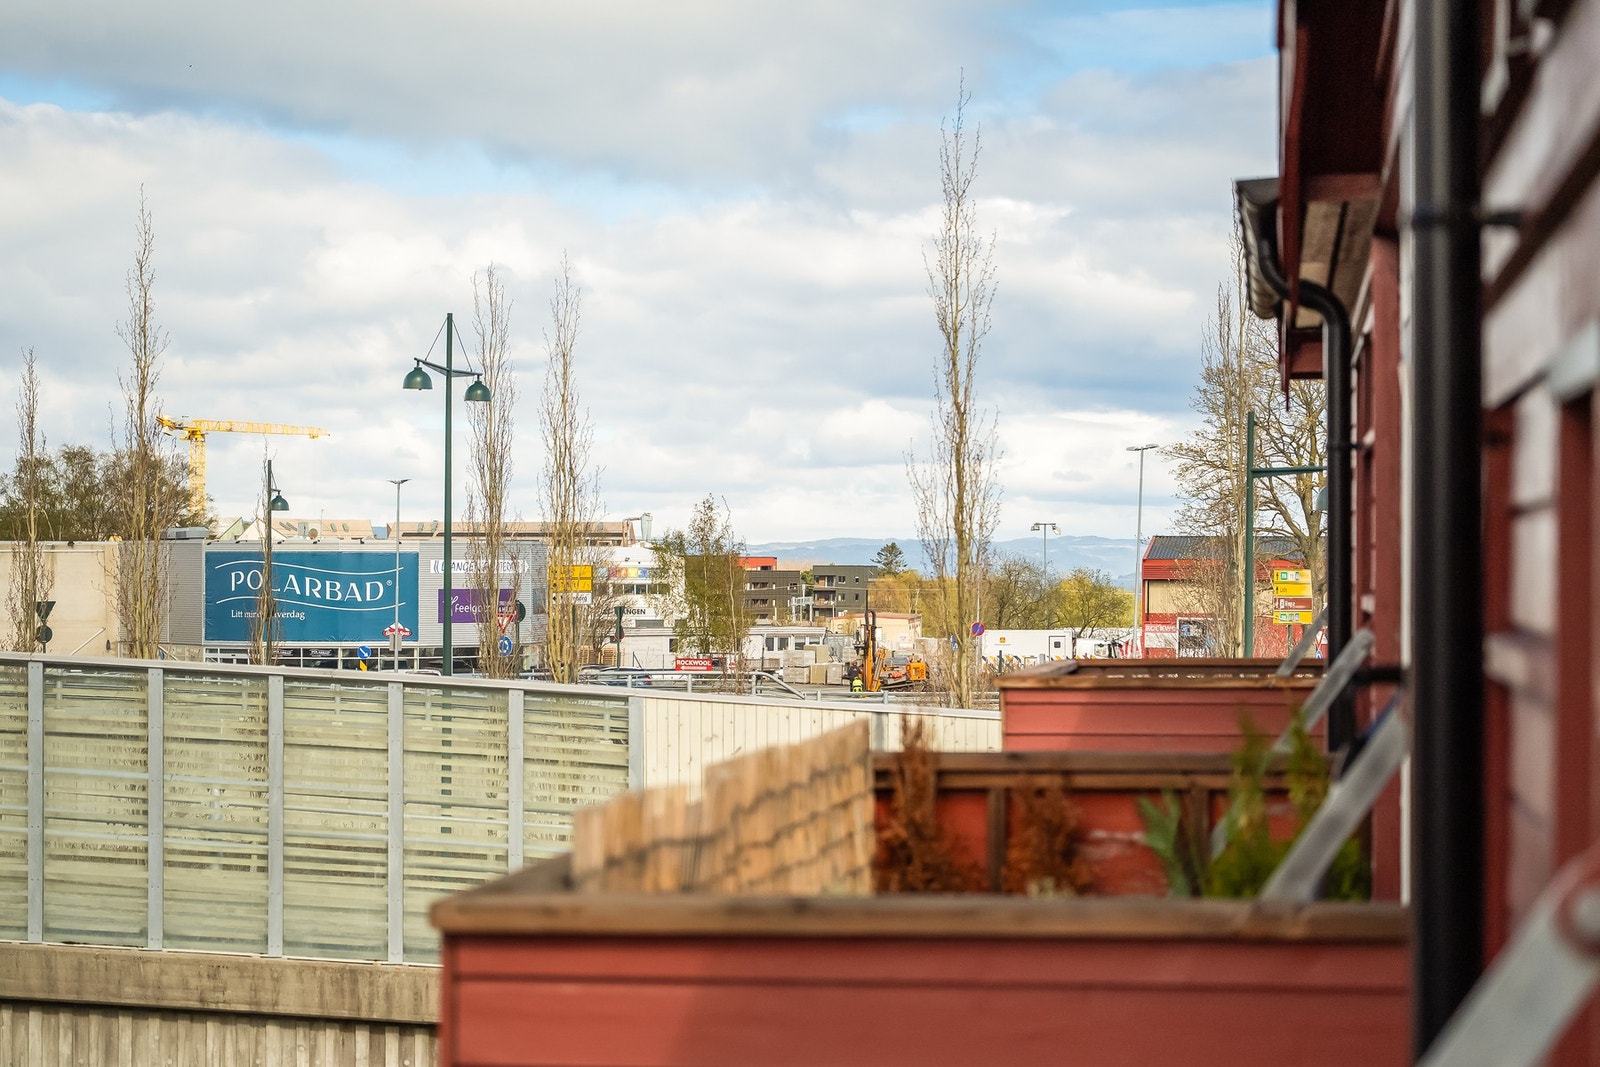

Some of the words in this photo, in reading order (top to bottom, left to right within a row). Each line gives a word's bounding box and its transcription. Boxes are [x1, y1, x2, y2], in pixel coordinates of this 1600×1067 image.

[454, 603, 495, 615] feelgo
[231, 610, 243, 618] Litt
[676, 659, 712, 667] ROCKWOOL
